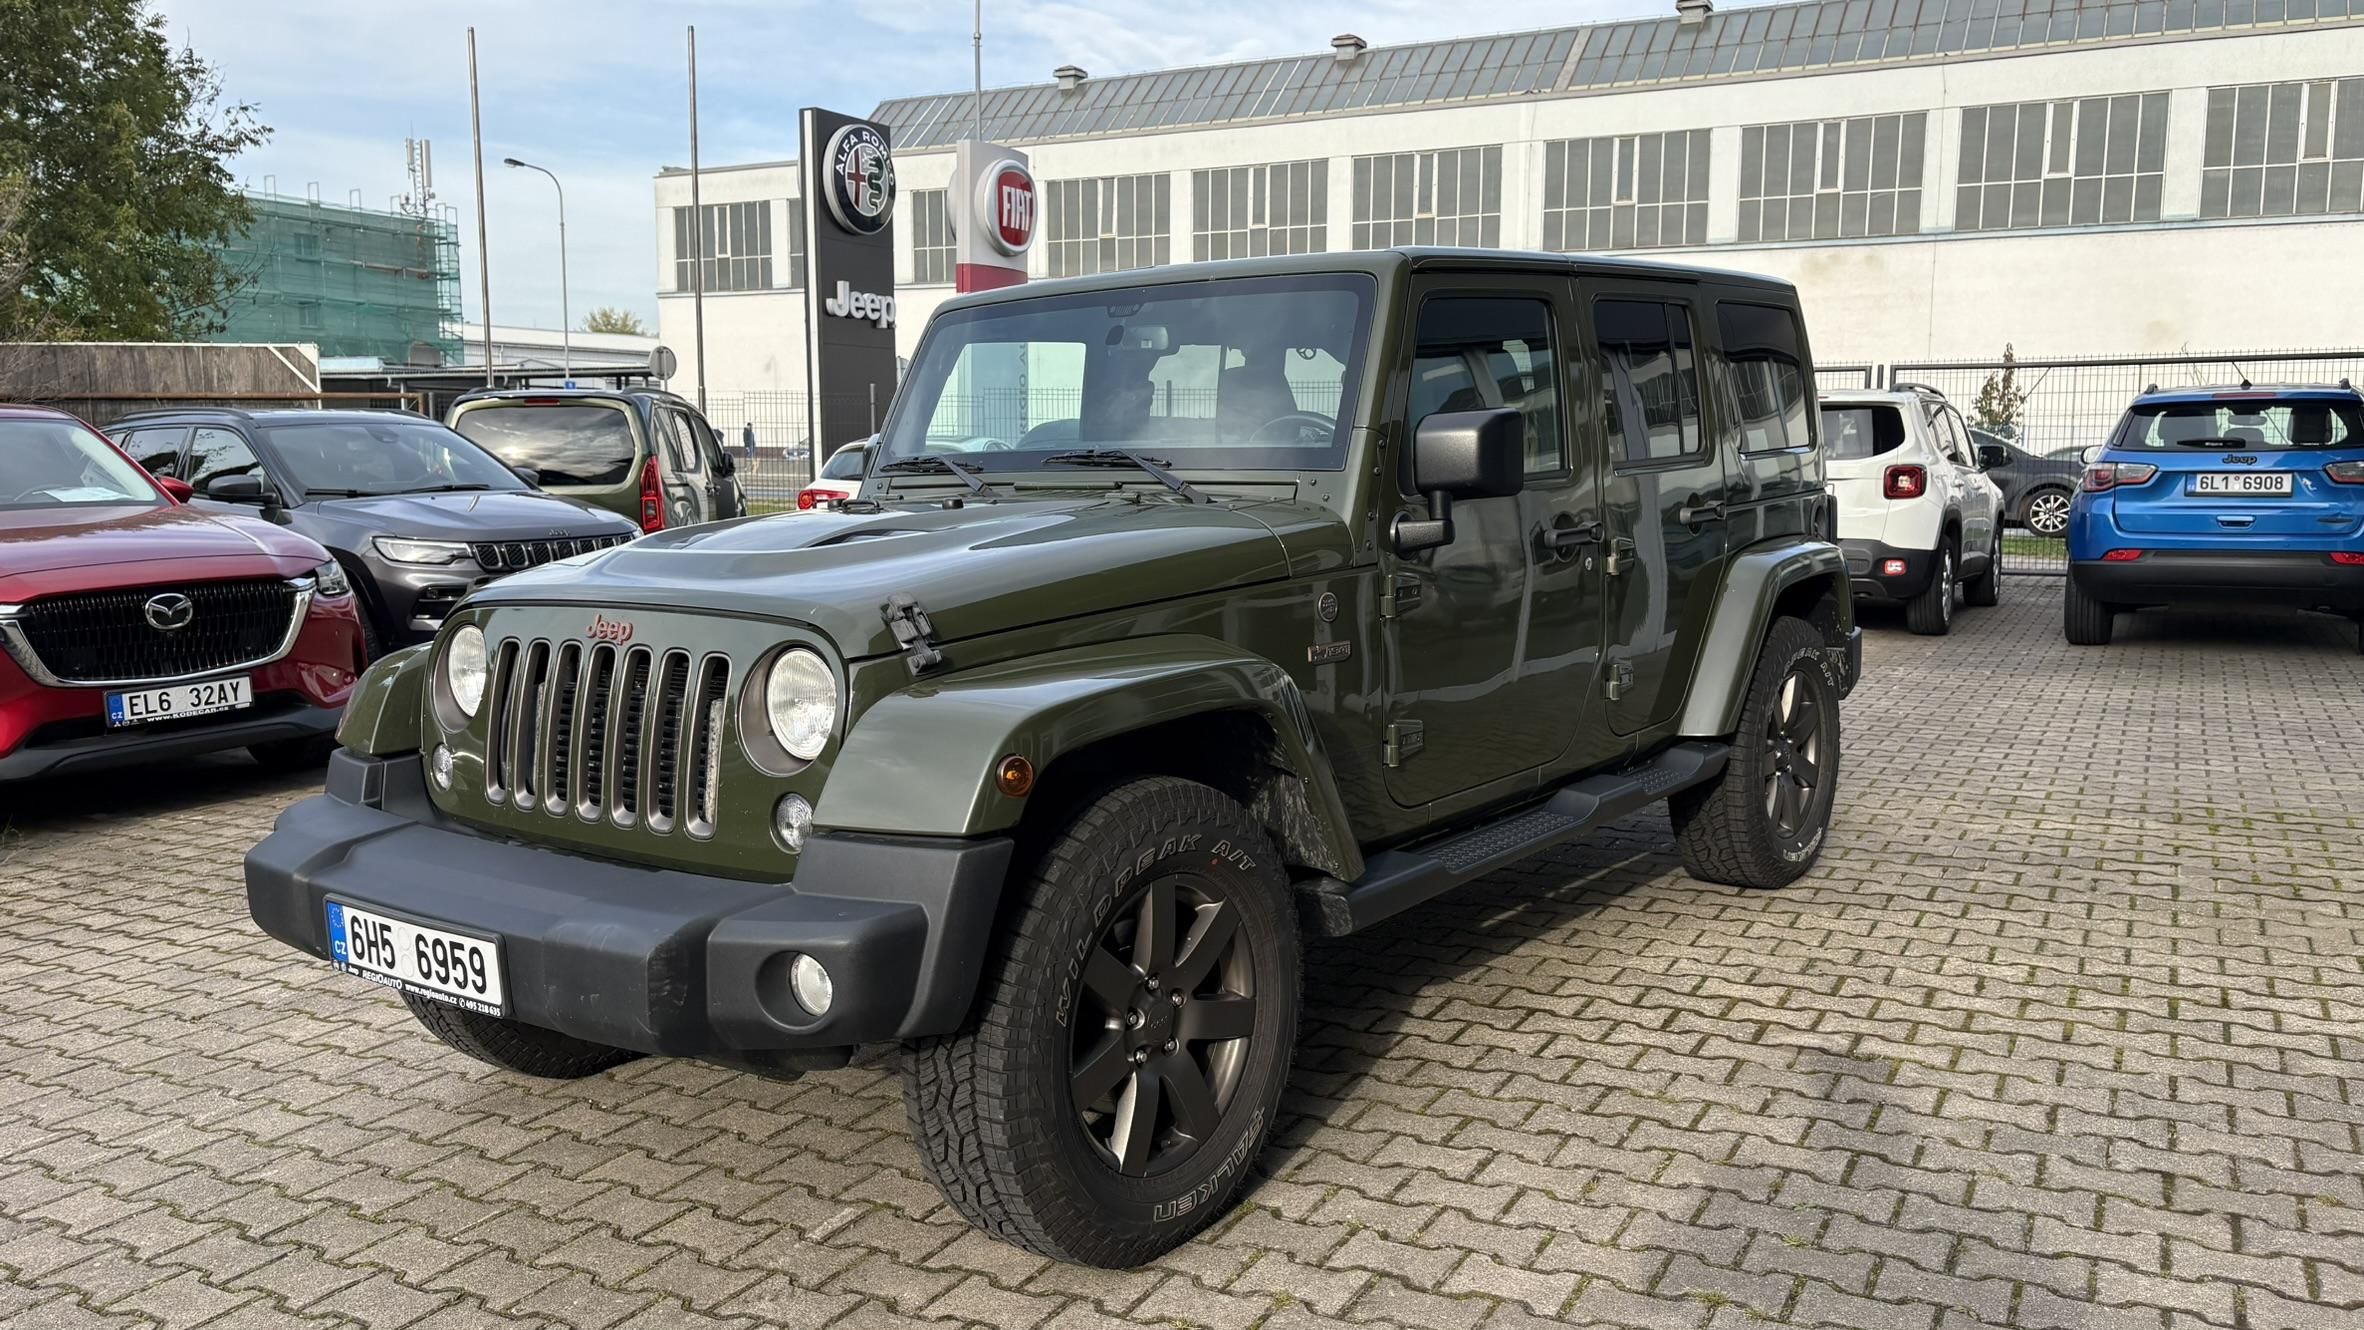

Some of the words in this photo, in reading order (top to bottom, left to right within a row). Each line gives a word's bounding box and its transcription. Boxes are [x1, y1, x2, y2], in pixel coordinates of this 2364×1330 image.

[835, 134, 858, 176] ALFA
[863, 131, 895, 187] ROMEO
[1002, 185, 1032, 232] FIAT
[826, 280, 896, 329] Jeep
[2222, 454, 2257, 465] Jeep
[2200, 476, 2229, 490] 6L1
[2243, 476, 2284, 490] 6908
[586, 613, 634, 646] Jeep
[112, 712, 123, 720] CZ
[129, 692, 171, 716] EL6
[189, 681, 240, 708] 32AY
[335, 940, 347, 955] CZ
[1056, 833, 1203, 1027] WILDPEAK
[1211, 839, 1256, 872] A/T
[351, 915, 396, 970] 6H5
[415, 933, 487, 995] 6959
[362, 970, 402, 989] REGIOAUTO
[1153, 1106, 1265, 1222] FALKEN
